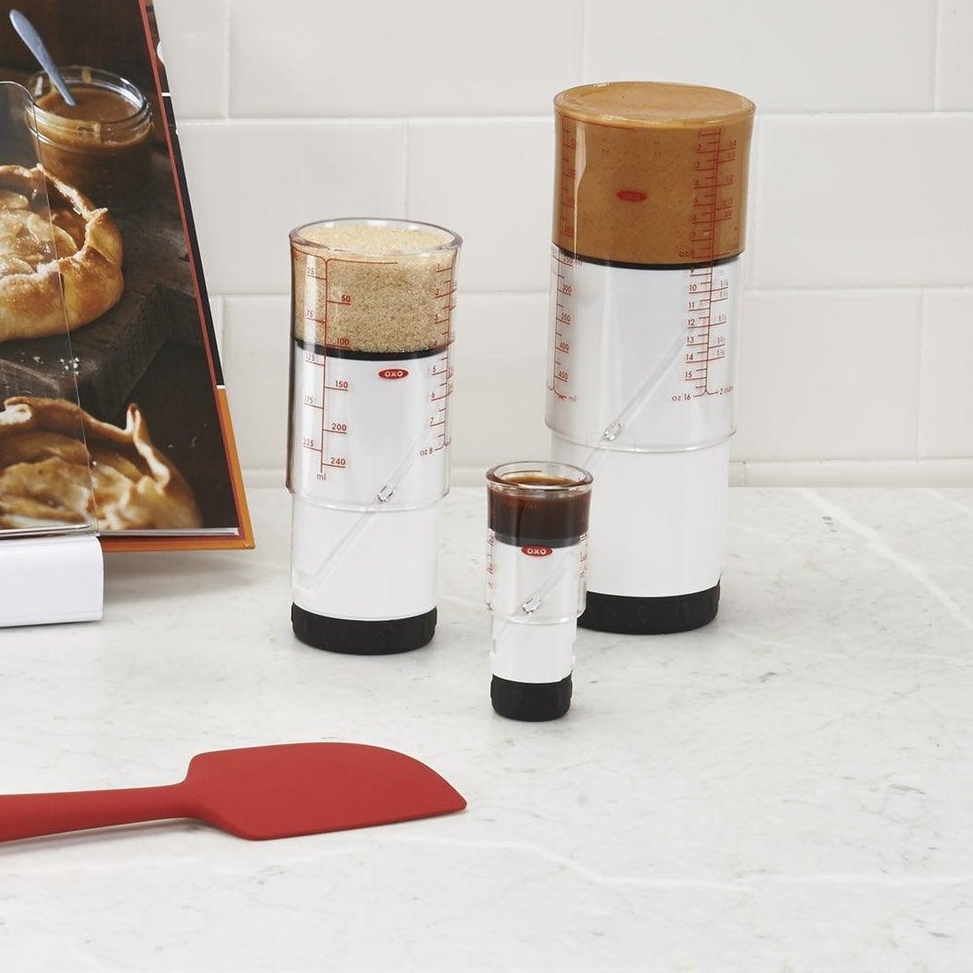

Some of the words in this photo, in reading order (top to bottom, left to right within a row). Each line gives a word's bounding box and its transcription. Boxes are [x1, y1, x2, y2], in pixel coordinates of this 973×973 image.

[341, 295, 351, 303] 50
[336, 337, 350, 346] 100
[687, 336, 694, 344] 13
[335, 380, 348, 388] 150
[331, 423, 347, 431] 200
[330, 457, 346, 466] 240
[527, 547, 547, 555] OXO
